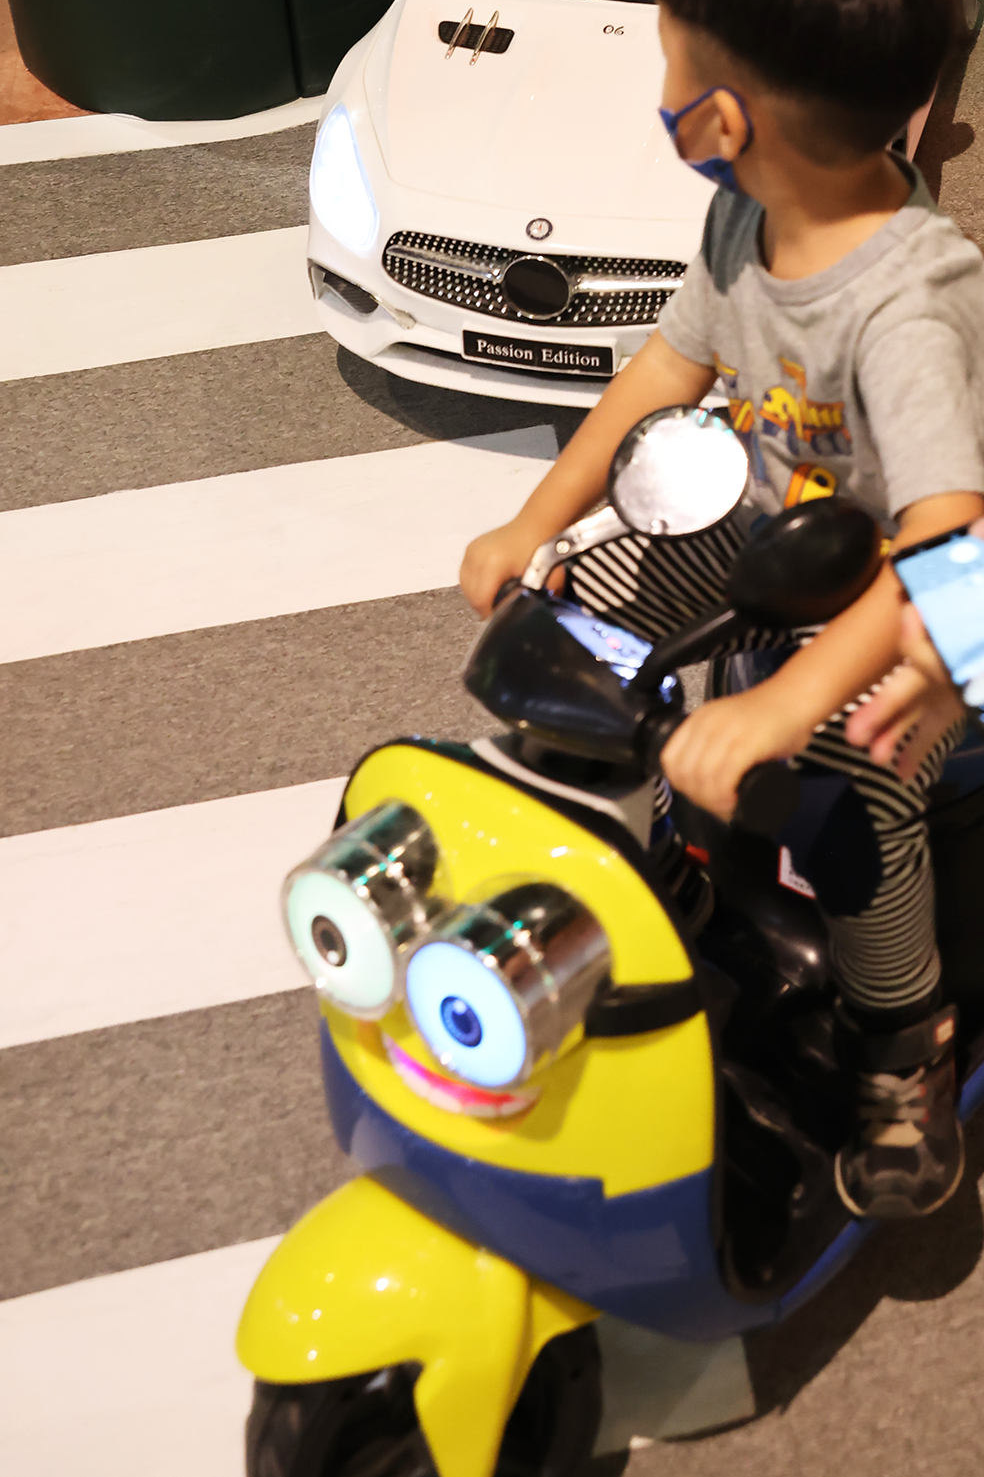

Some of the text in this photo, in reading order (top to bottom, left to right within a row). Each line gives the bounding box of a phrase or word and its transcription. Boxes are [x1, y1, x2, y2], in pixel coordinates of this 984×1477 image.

[603, 25, 624, 36] 06
[476, 339, 600, 367] Passion Edition
